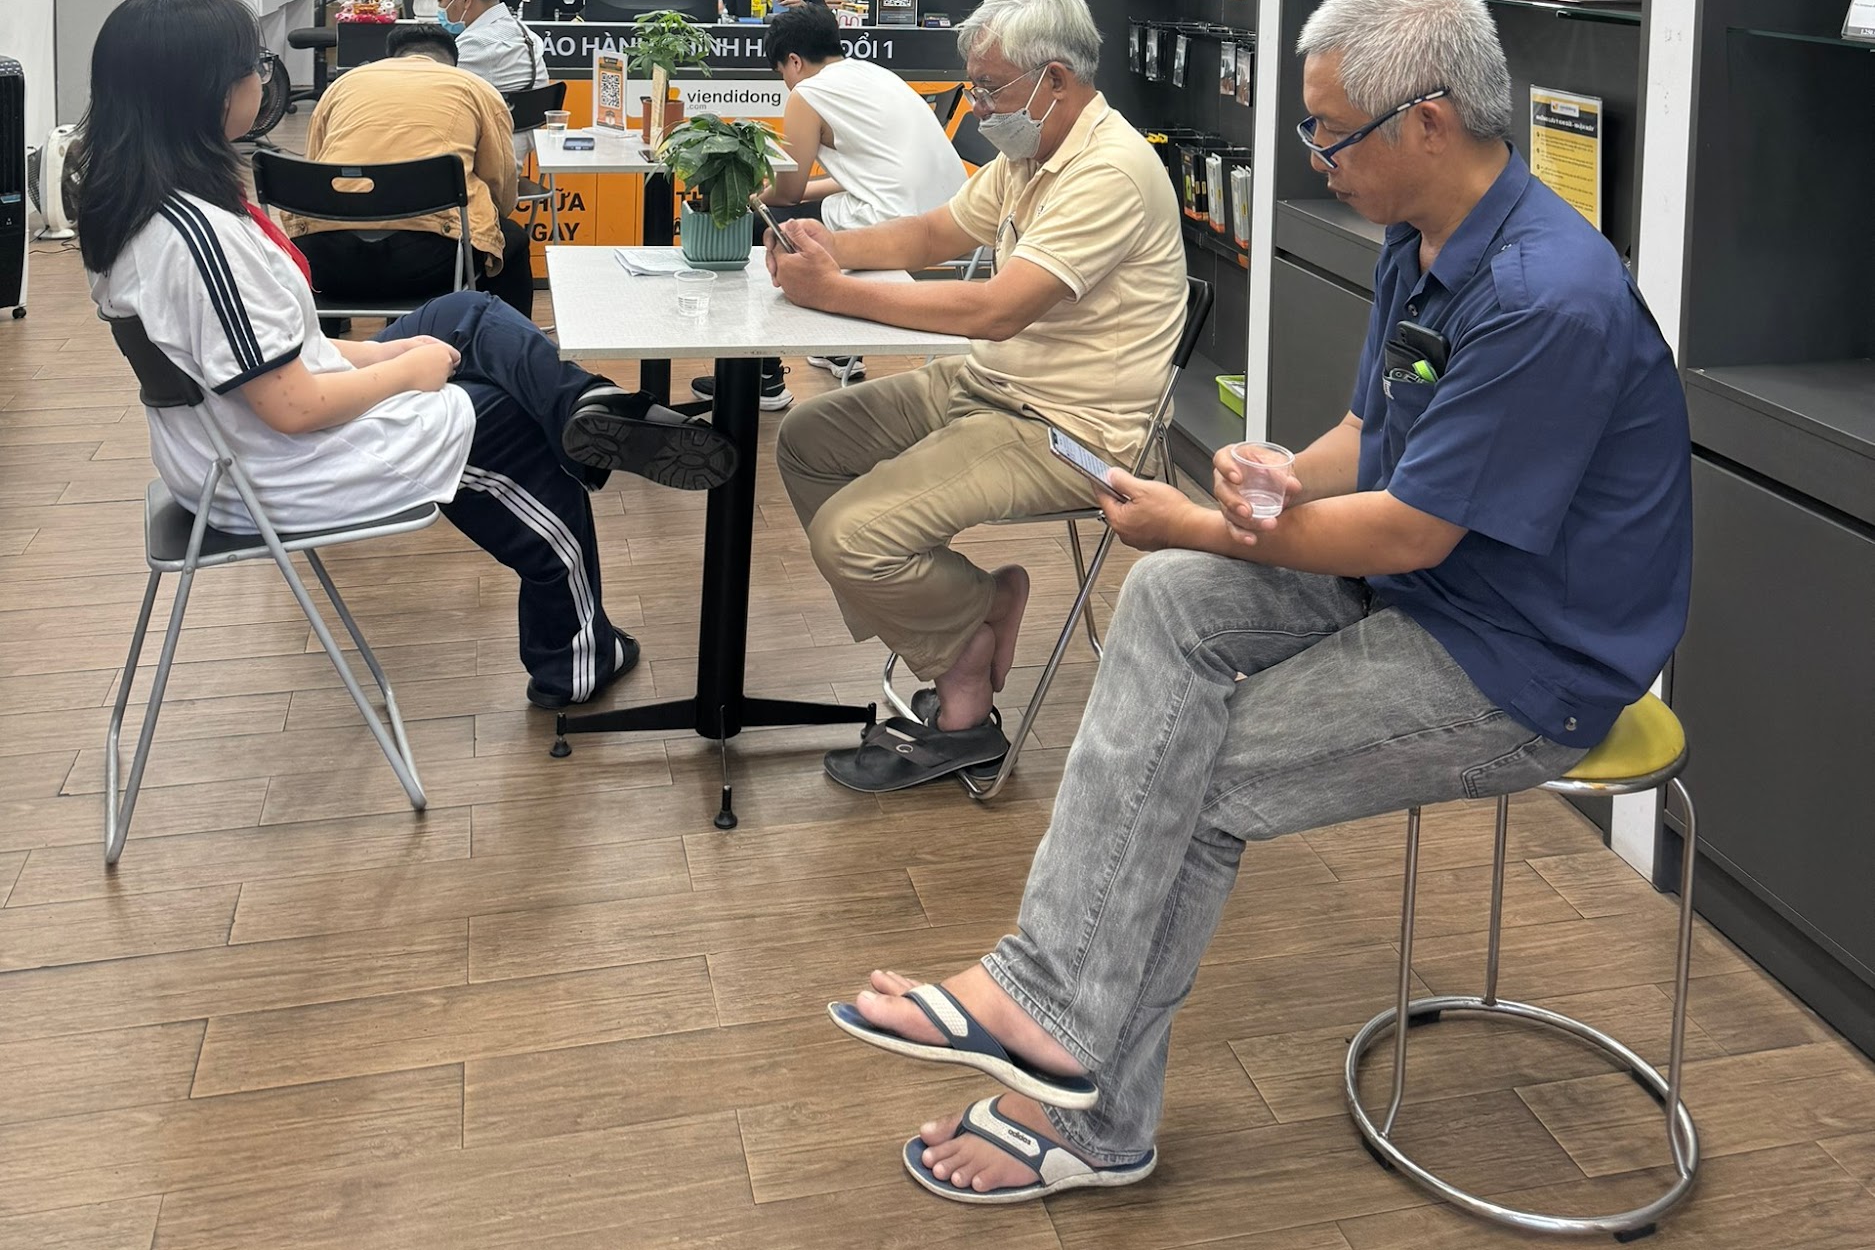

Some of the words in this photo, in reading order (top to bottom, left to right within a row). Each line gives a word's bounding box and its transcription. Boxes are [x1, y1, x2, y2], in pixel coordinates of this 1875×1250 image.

[543, 30, 577, 57] ẢO
[581, 31, 643, 57] HÀN
[882, 39, 894, 59] 1
[686, 88, 782, 107] viendidong
[686, 102, 708, 110] .com
[524, 222, 581, 242] GAY
[1007, 1129, 1032, 1146] adidas
